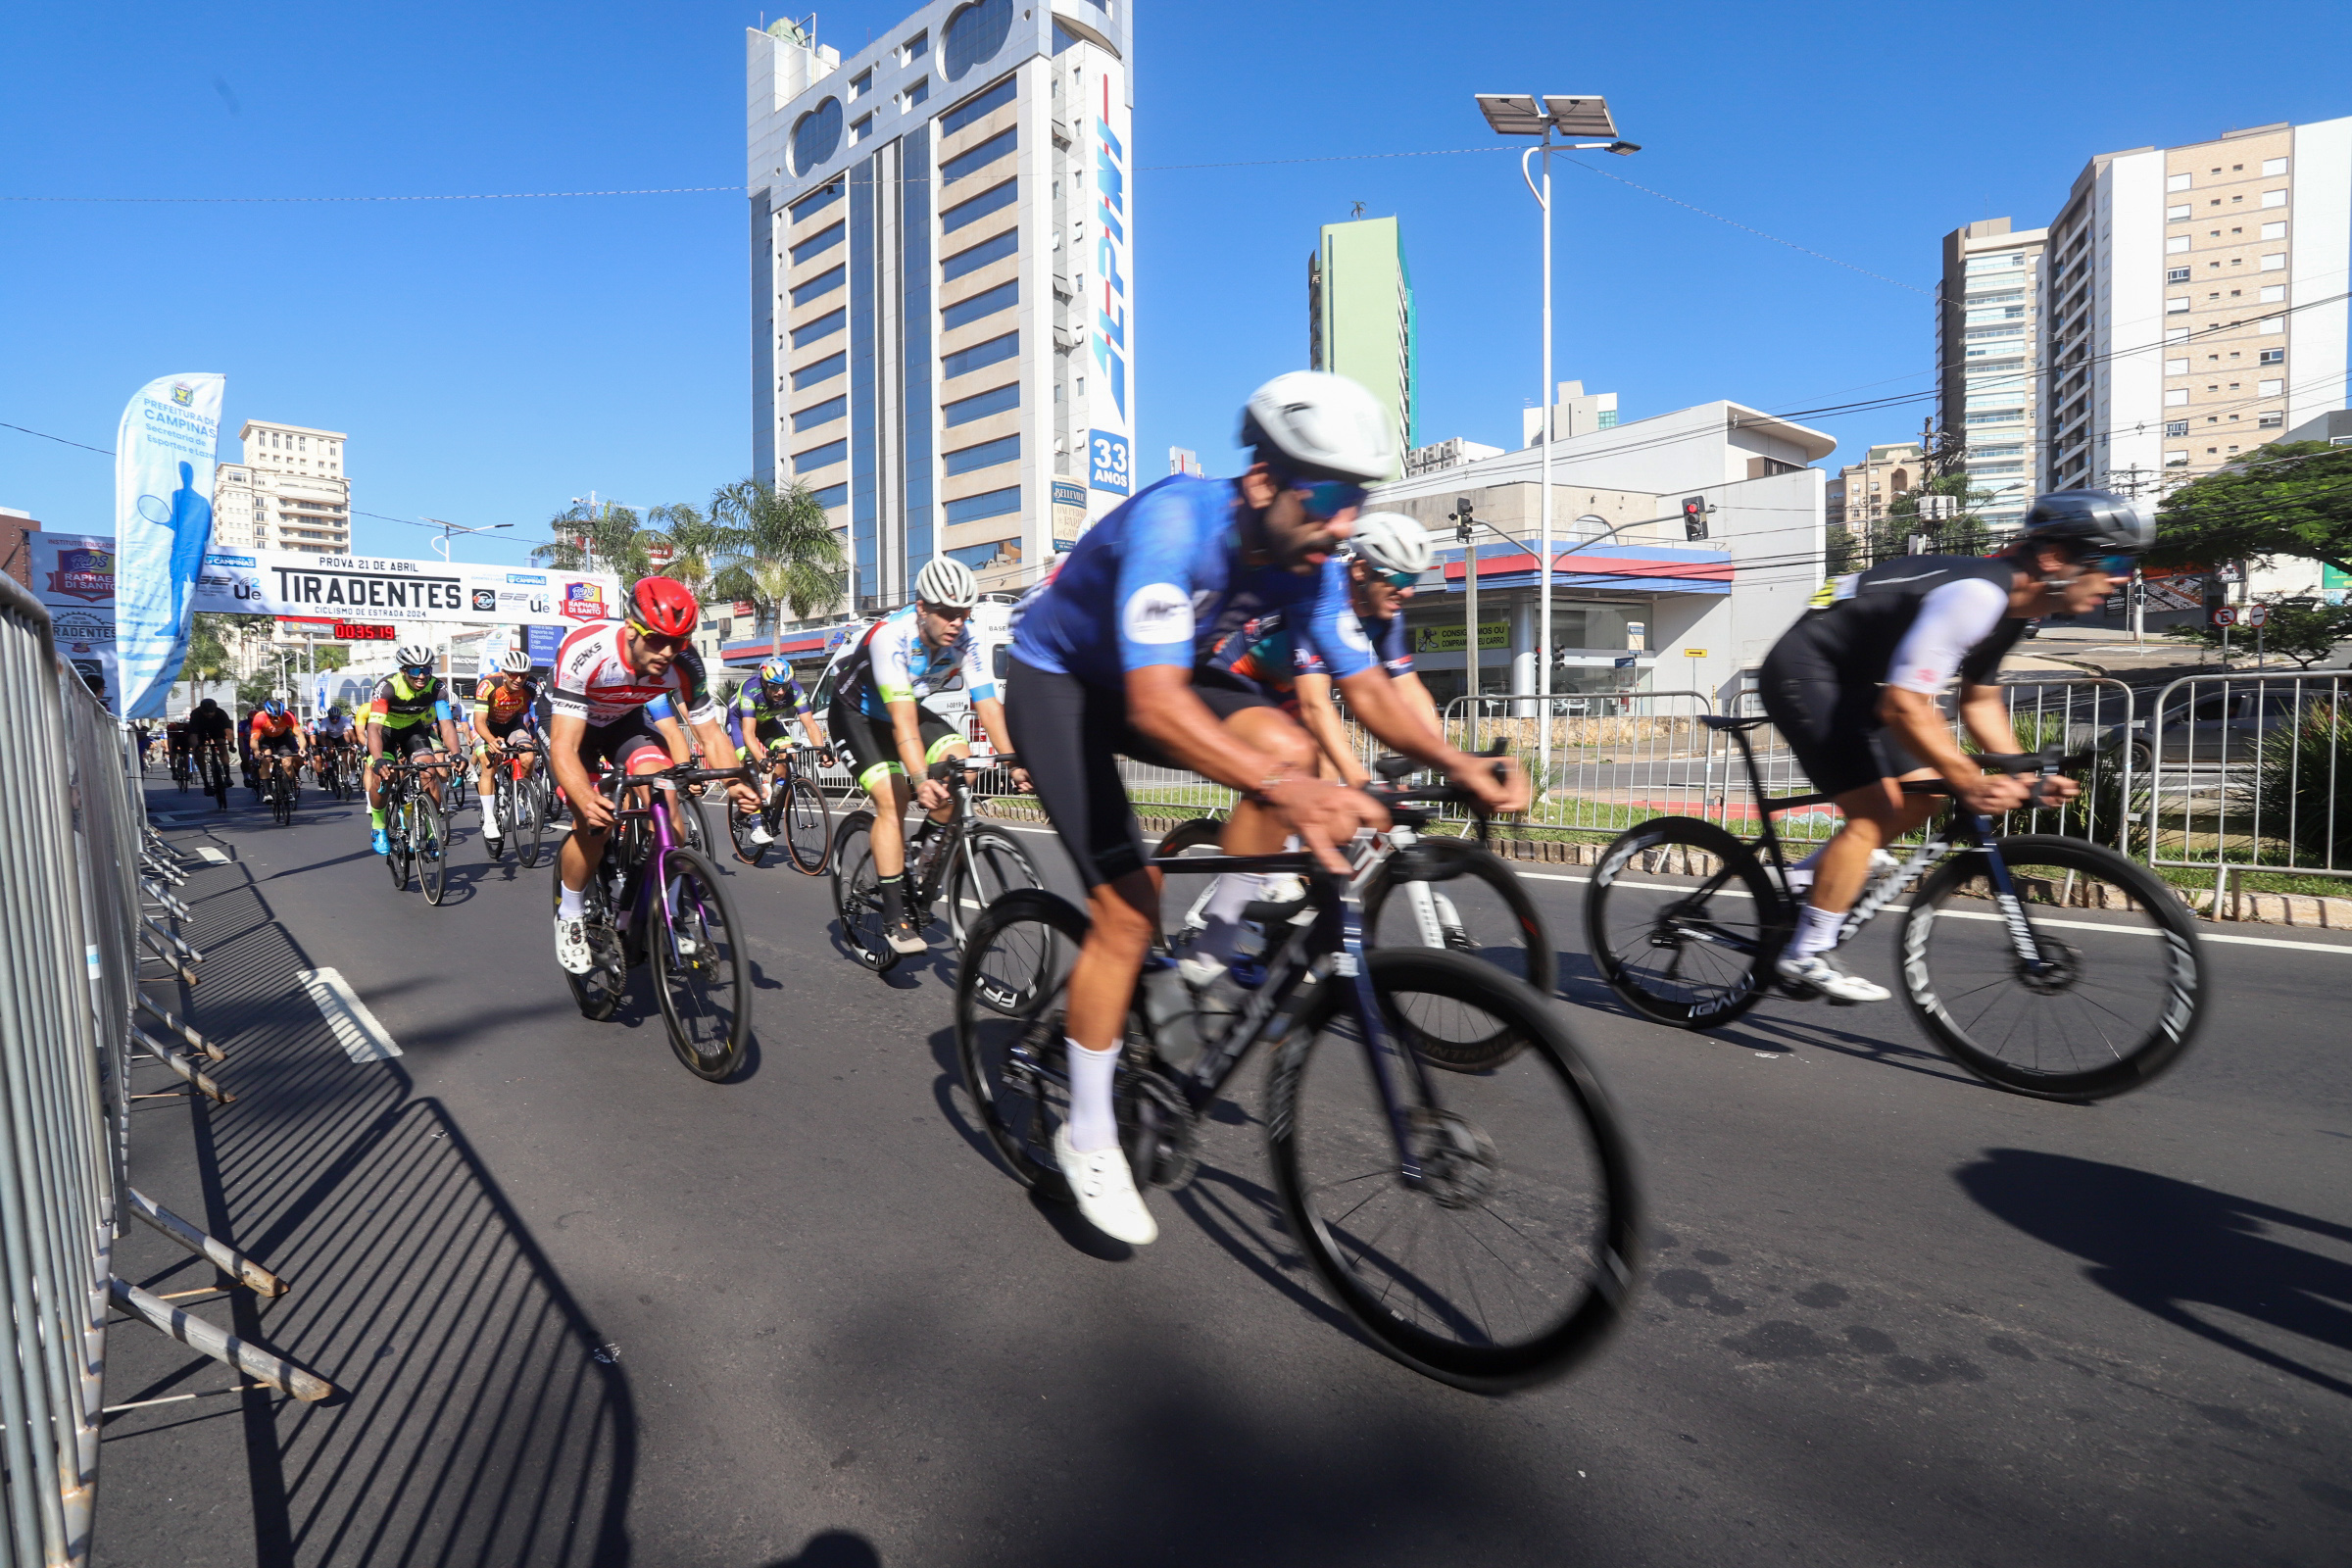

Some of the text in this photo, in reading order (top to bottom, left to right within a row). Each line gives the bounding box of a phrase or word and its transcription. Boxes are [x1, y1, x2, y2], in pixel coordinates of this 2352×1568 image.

[144, 398, 216, 427] PREFEITURA DE
[144, 409, 217, 439] CAMPINAS
[145, 422, 195, 443] Secretaria
[147, 434, 187, 453] Esportes
[195, 448, 217, 460] Laze
[1094, 438, 1128, 473] 33
[1094, 468, 1128, 488] ANOS
[71, 555, 109, 568] RDS
[214, 558, 255, 567] CAMPINAS
[318, 557, 419, 572] PROVA 21 DE ABRIL
[271, 566, 462, 610] TIRADENTES
[315, 606, 353, 615] CICLISMO
[368, 608, 404, 617] ESTRADA
[568, 601, 602, 610] RAPHAEL
[53, 627, 116, 638] RADENTES
[1442, 625, 1505, 638] CONSIGMOS OU
[1442, 639, 1467, 648] COMPRAM
[1486, 636, 1505, 645] CARRO
[570, 641, 603, 675] PENKS
[552, 700, 588, 712] PENKS
